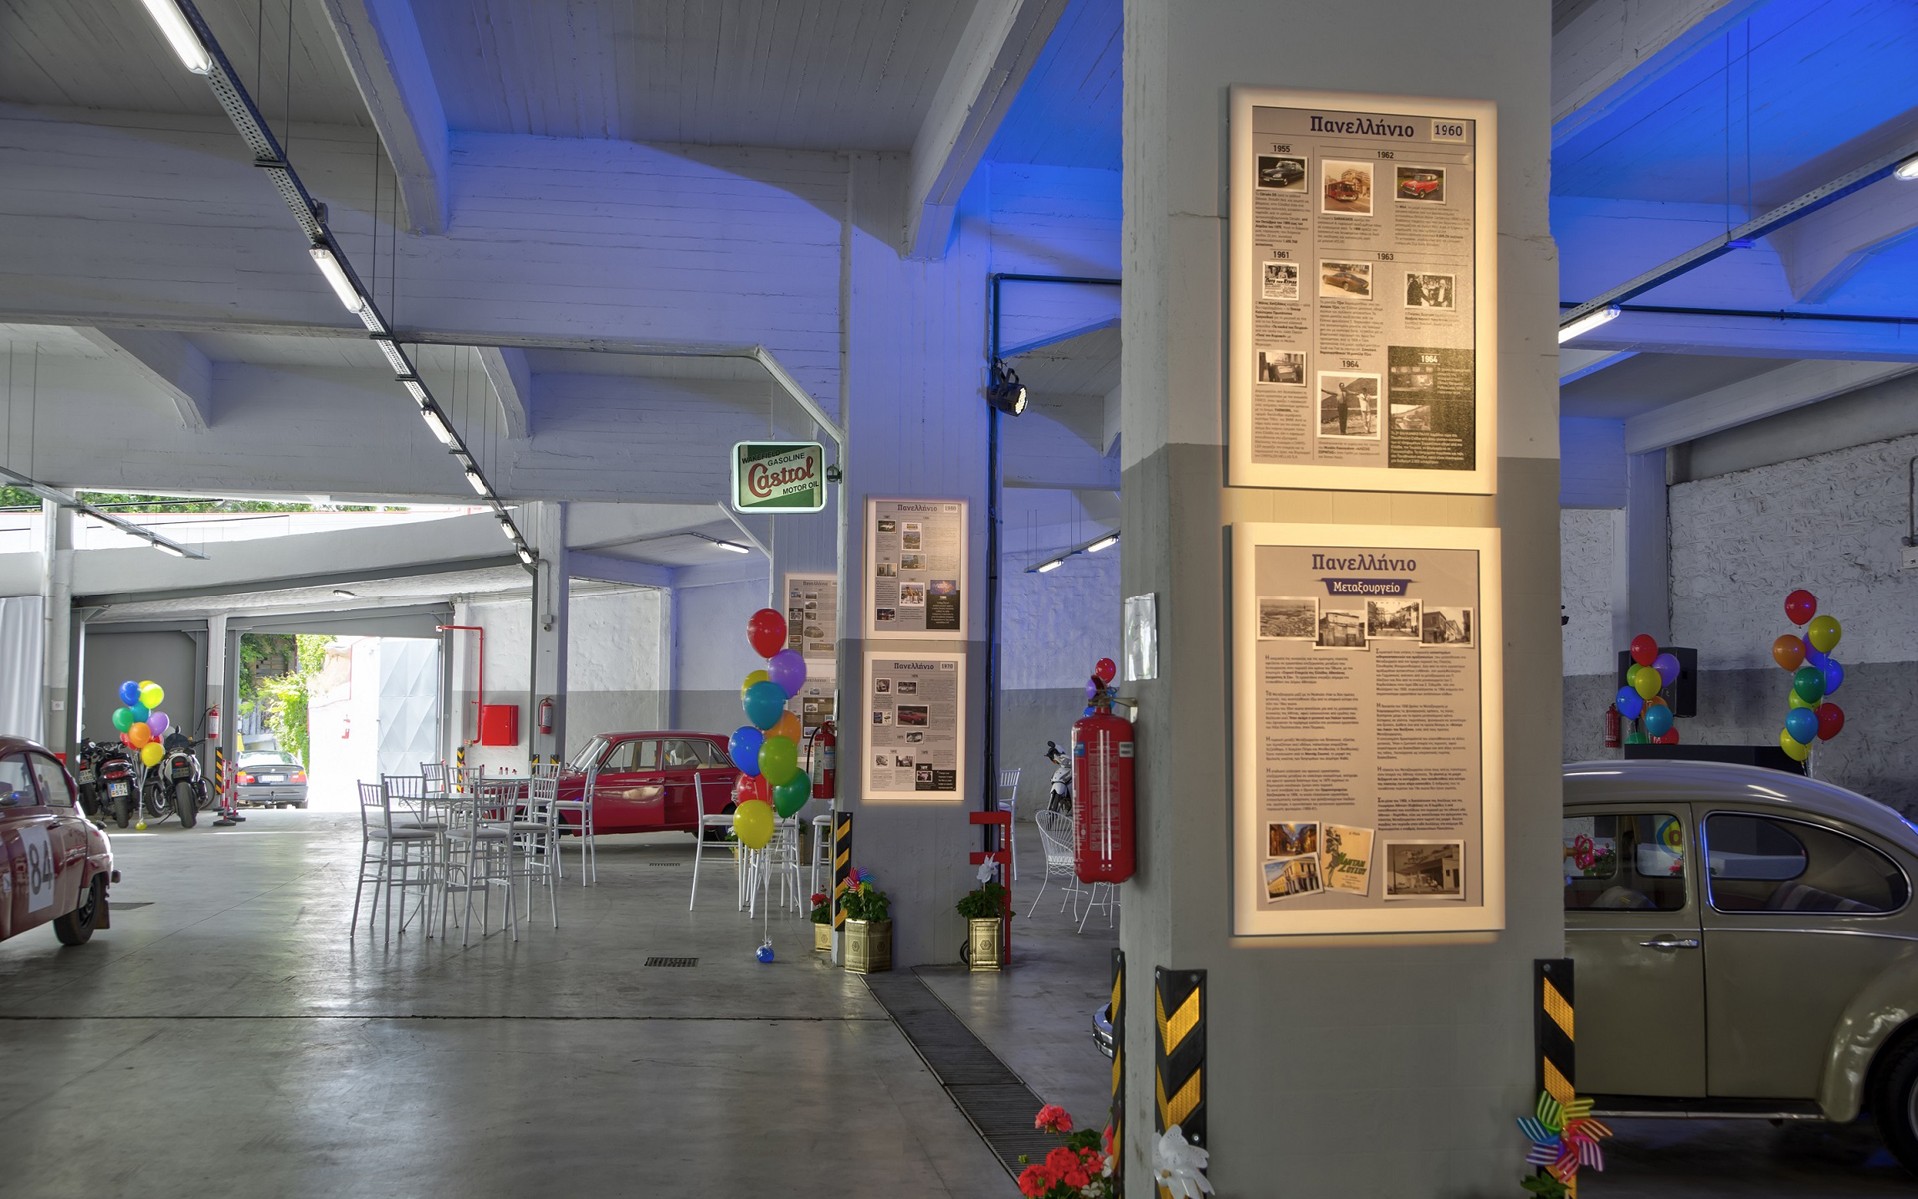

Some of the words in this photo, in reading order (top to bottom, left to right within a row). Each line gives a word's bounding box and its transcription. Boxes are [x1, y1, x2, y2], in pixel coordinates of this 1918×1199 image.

[1310, 116, 1415, 137] Πανελλήνιο
[1434, 124, 1463, 137] 1960
[1273, 145, 1291, 153] 1955
[1377, 151, 1394, 159] 1962
[1273, 251, 1290, 259] 1961
[1377, 253, 1394, 261] 1963
[1342, 360, 1360, 368] 1964
[741, 450, 781, 464] WAKEFIELD
[768, 453, 805, 467] GASOLINE
[748, 456, 814, 498] Castrol
[782, 485, 807, 495] MOTOR
[808, 481, 819, 489] OIL
[897, 504, 938, 512] Πανελλήνιο
[1312, 554, 1417, 572] Πανελλήνιο
[1333, 581, 1401, 595] Μεταξουργείο
[894, 662, 934, 670] Πανελλήνιο
[28, 840, 53, 895] 84
